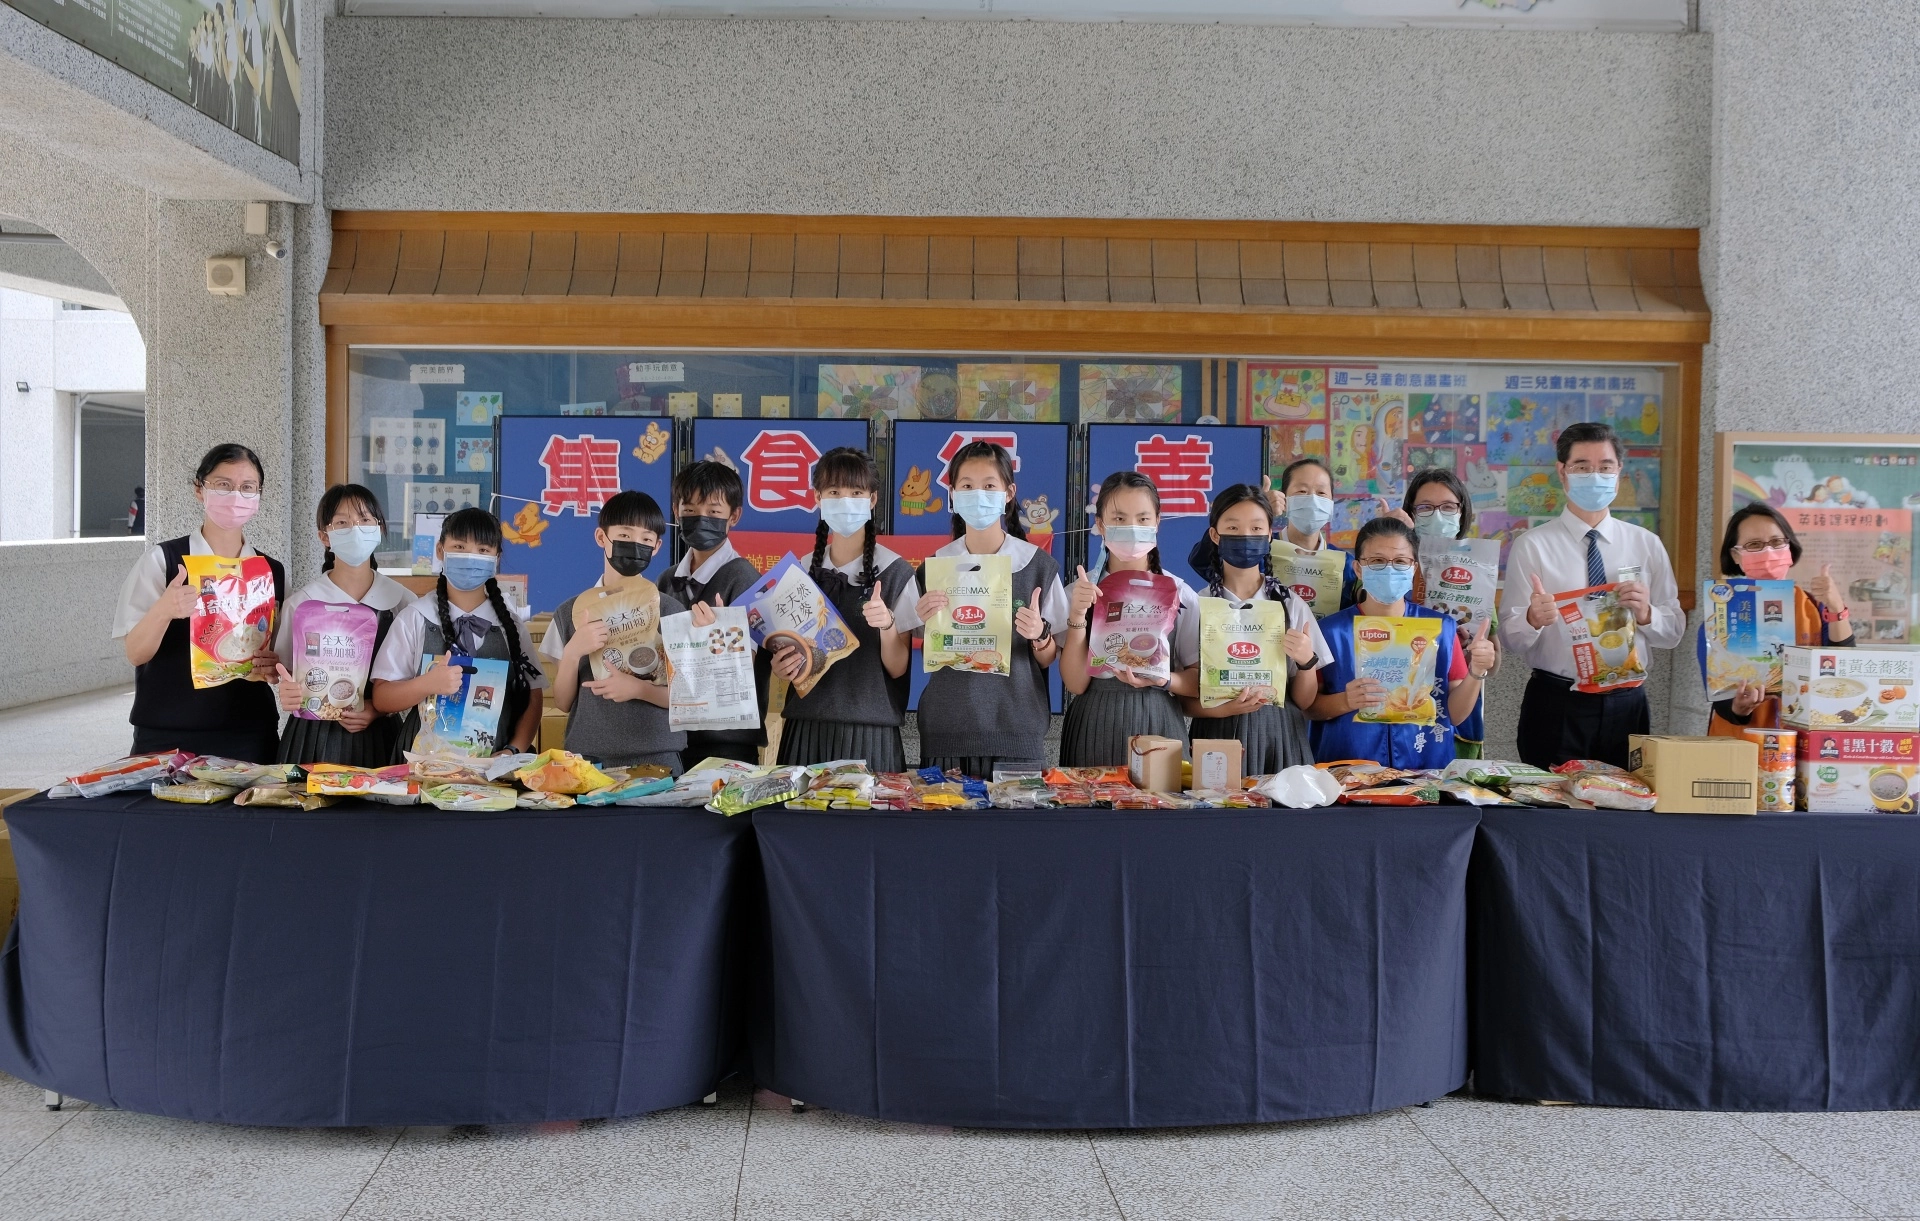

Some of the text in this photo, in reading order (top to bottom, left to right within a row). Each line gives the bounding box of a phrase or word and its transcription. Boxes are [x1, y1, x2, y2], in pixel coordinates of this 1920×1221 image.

[1854, 456, 1917, 466] WELCOME
[540, 434, 622, 517] 集
[741, 430, 822, 513] 食
[1135, 434, 1213, 516] 善
[1798, 513, 1889, 528] 英語課程規劃
[1284, 564, 1324, 576] GREENMAX
[1444, 569, 1471, 581] 馬玉山
[945, 586, 990, 595] GREENMAX
[774, 582, 812, 618] 全天然
[605, 605, 645, 625] 全天然
[955, 608, 983, 621] 馬玉山
[1123, 603, 1163, 614] 全天然
[608, 617, 646, 637] 無加糖
[1221, 623, 1264, 632] GREENMAX
[322, 634, 356, 648] 全天然
[708, 626, 746, 655] 32
[1361, 631, 1388, 640] Lipton
[322, 647, 356, 659] 無加糖
[1231, 644, 1258, 656] 馬玉山
[1849, 659, 1908, 675] 黃金蕎麥
[1370, 669, 1404, 683] 奶茶
[1851, 738, 1894, 754] 黑十穀
